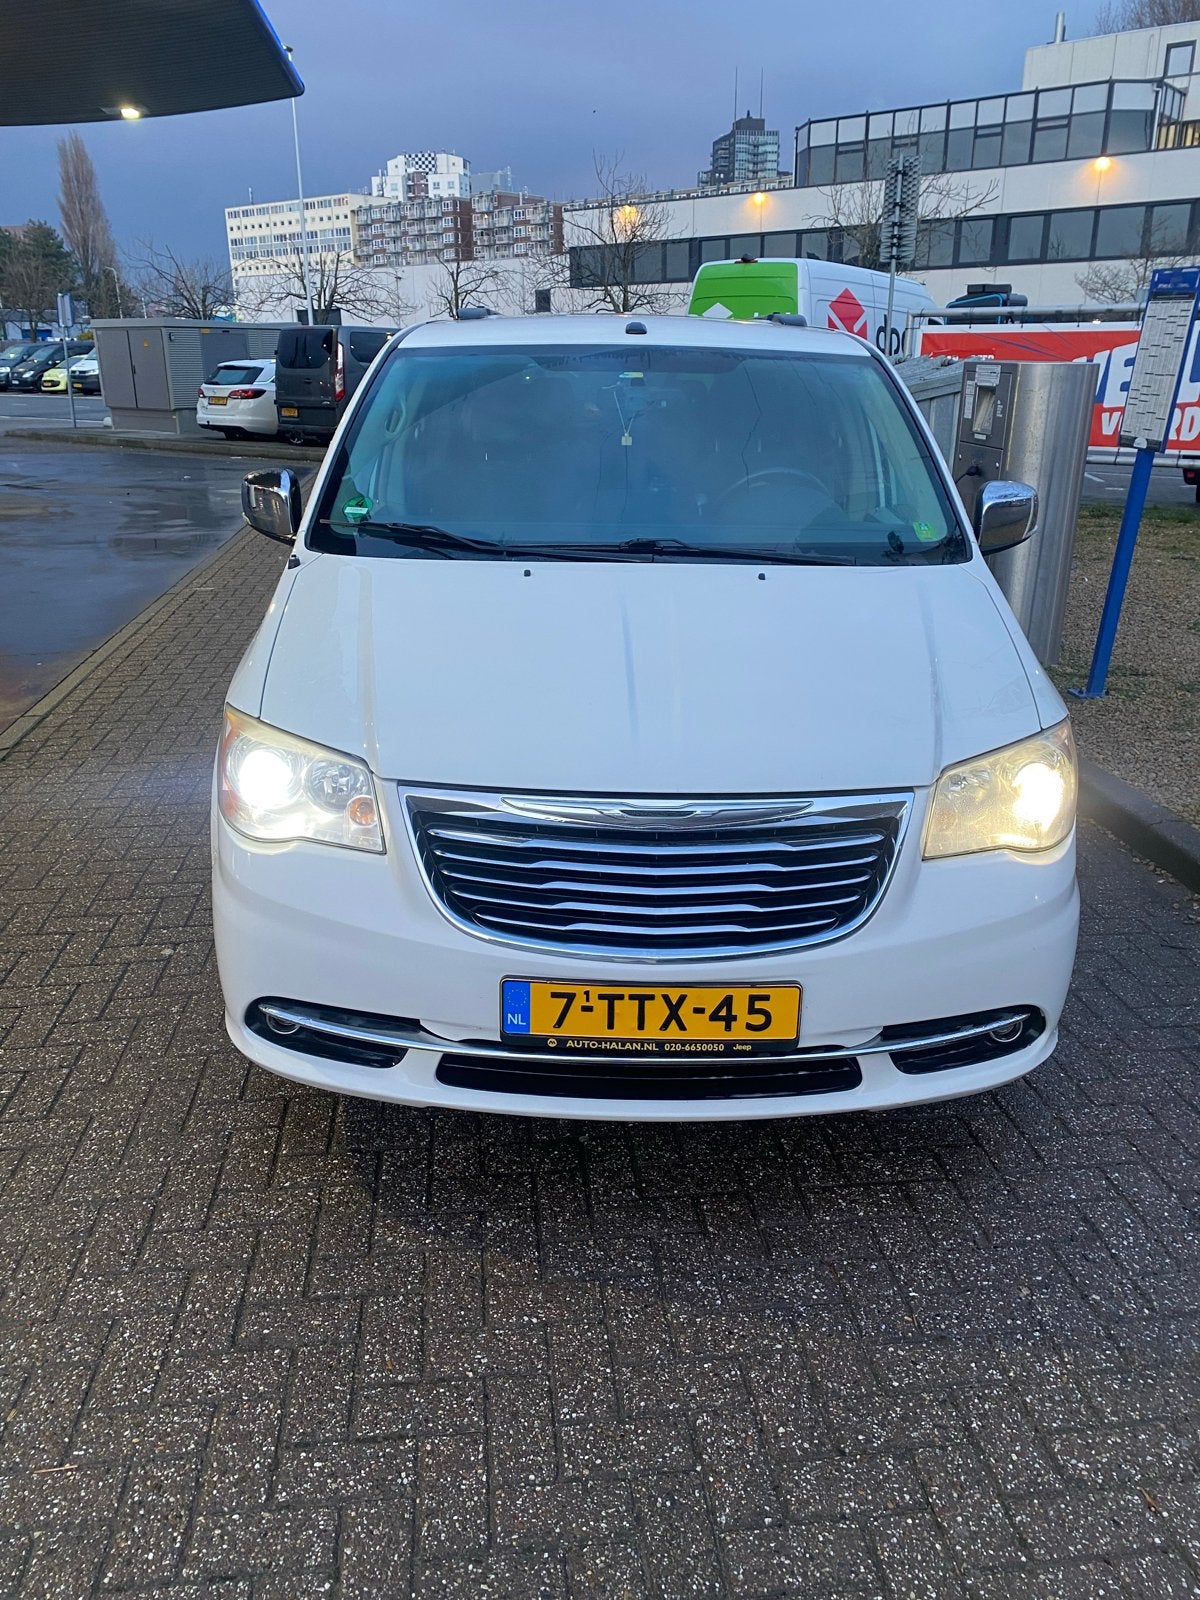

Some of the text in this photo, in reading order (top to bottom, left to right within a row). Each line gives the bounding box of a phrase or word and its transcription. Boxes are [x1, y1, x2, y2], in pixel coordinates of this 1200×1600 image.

[507, 1013, 526, 1025] NL
[566, 1040, 659, 1051] AUTO-HALAN.NL
[664, 1043, 725, 1052] 020-6650050
[733, 1043, 752, 1051] Jeep
